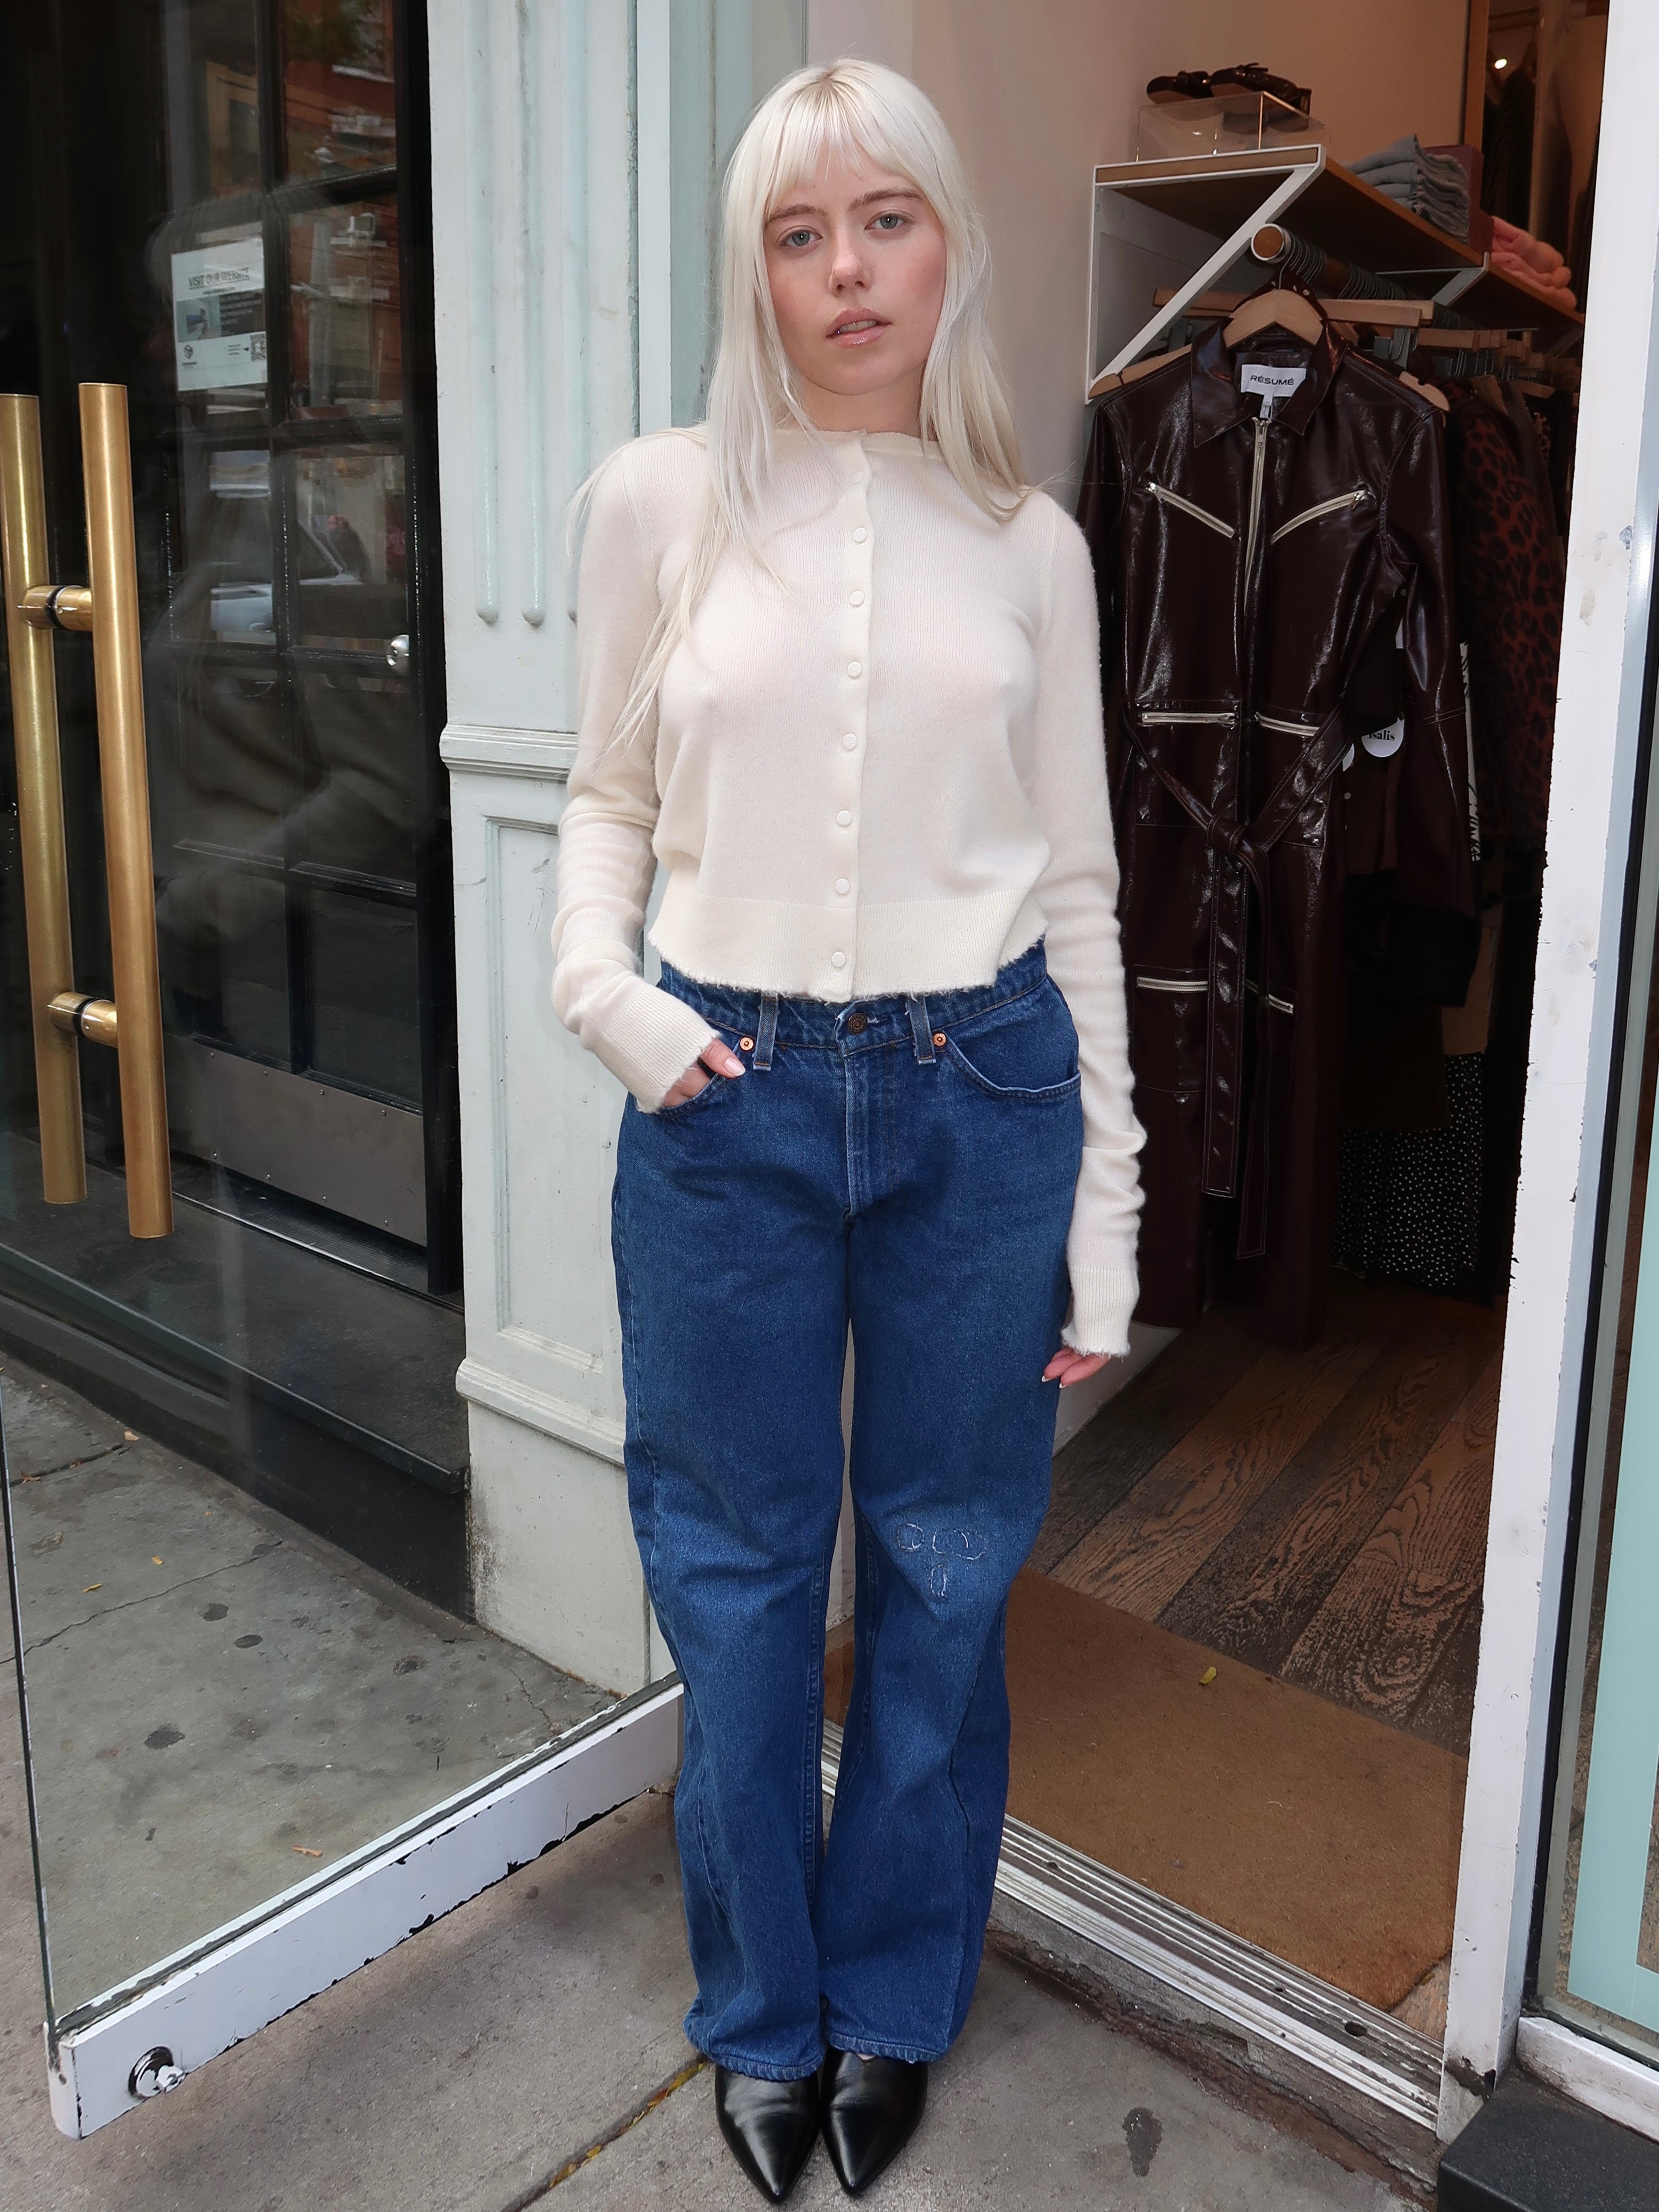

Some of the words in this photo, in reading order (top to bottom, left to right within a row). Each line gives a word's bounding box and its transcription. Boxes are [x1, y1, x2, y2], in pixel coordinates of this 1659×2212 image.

[188, 275, 204, 287] VISIT
[205, 272, 220, 284] OUR
[221, 267, 249, 281] WEBSITE
[1250, 375, 1294, 385] RÉSUMÉ
